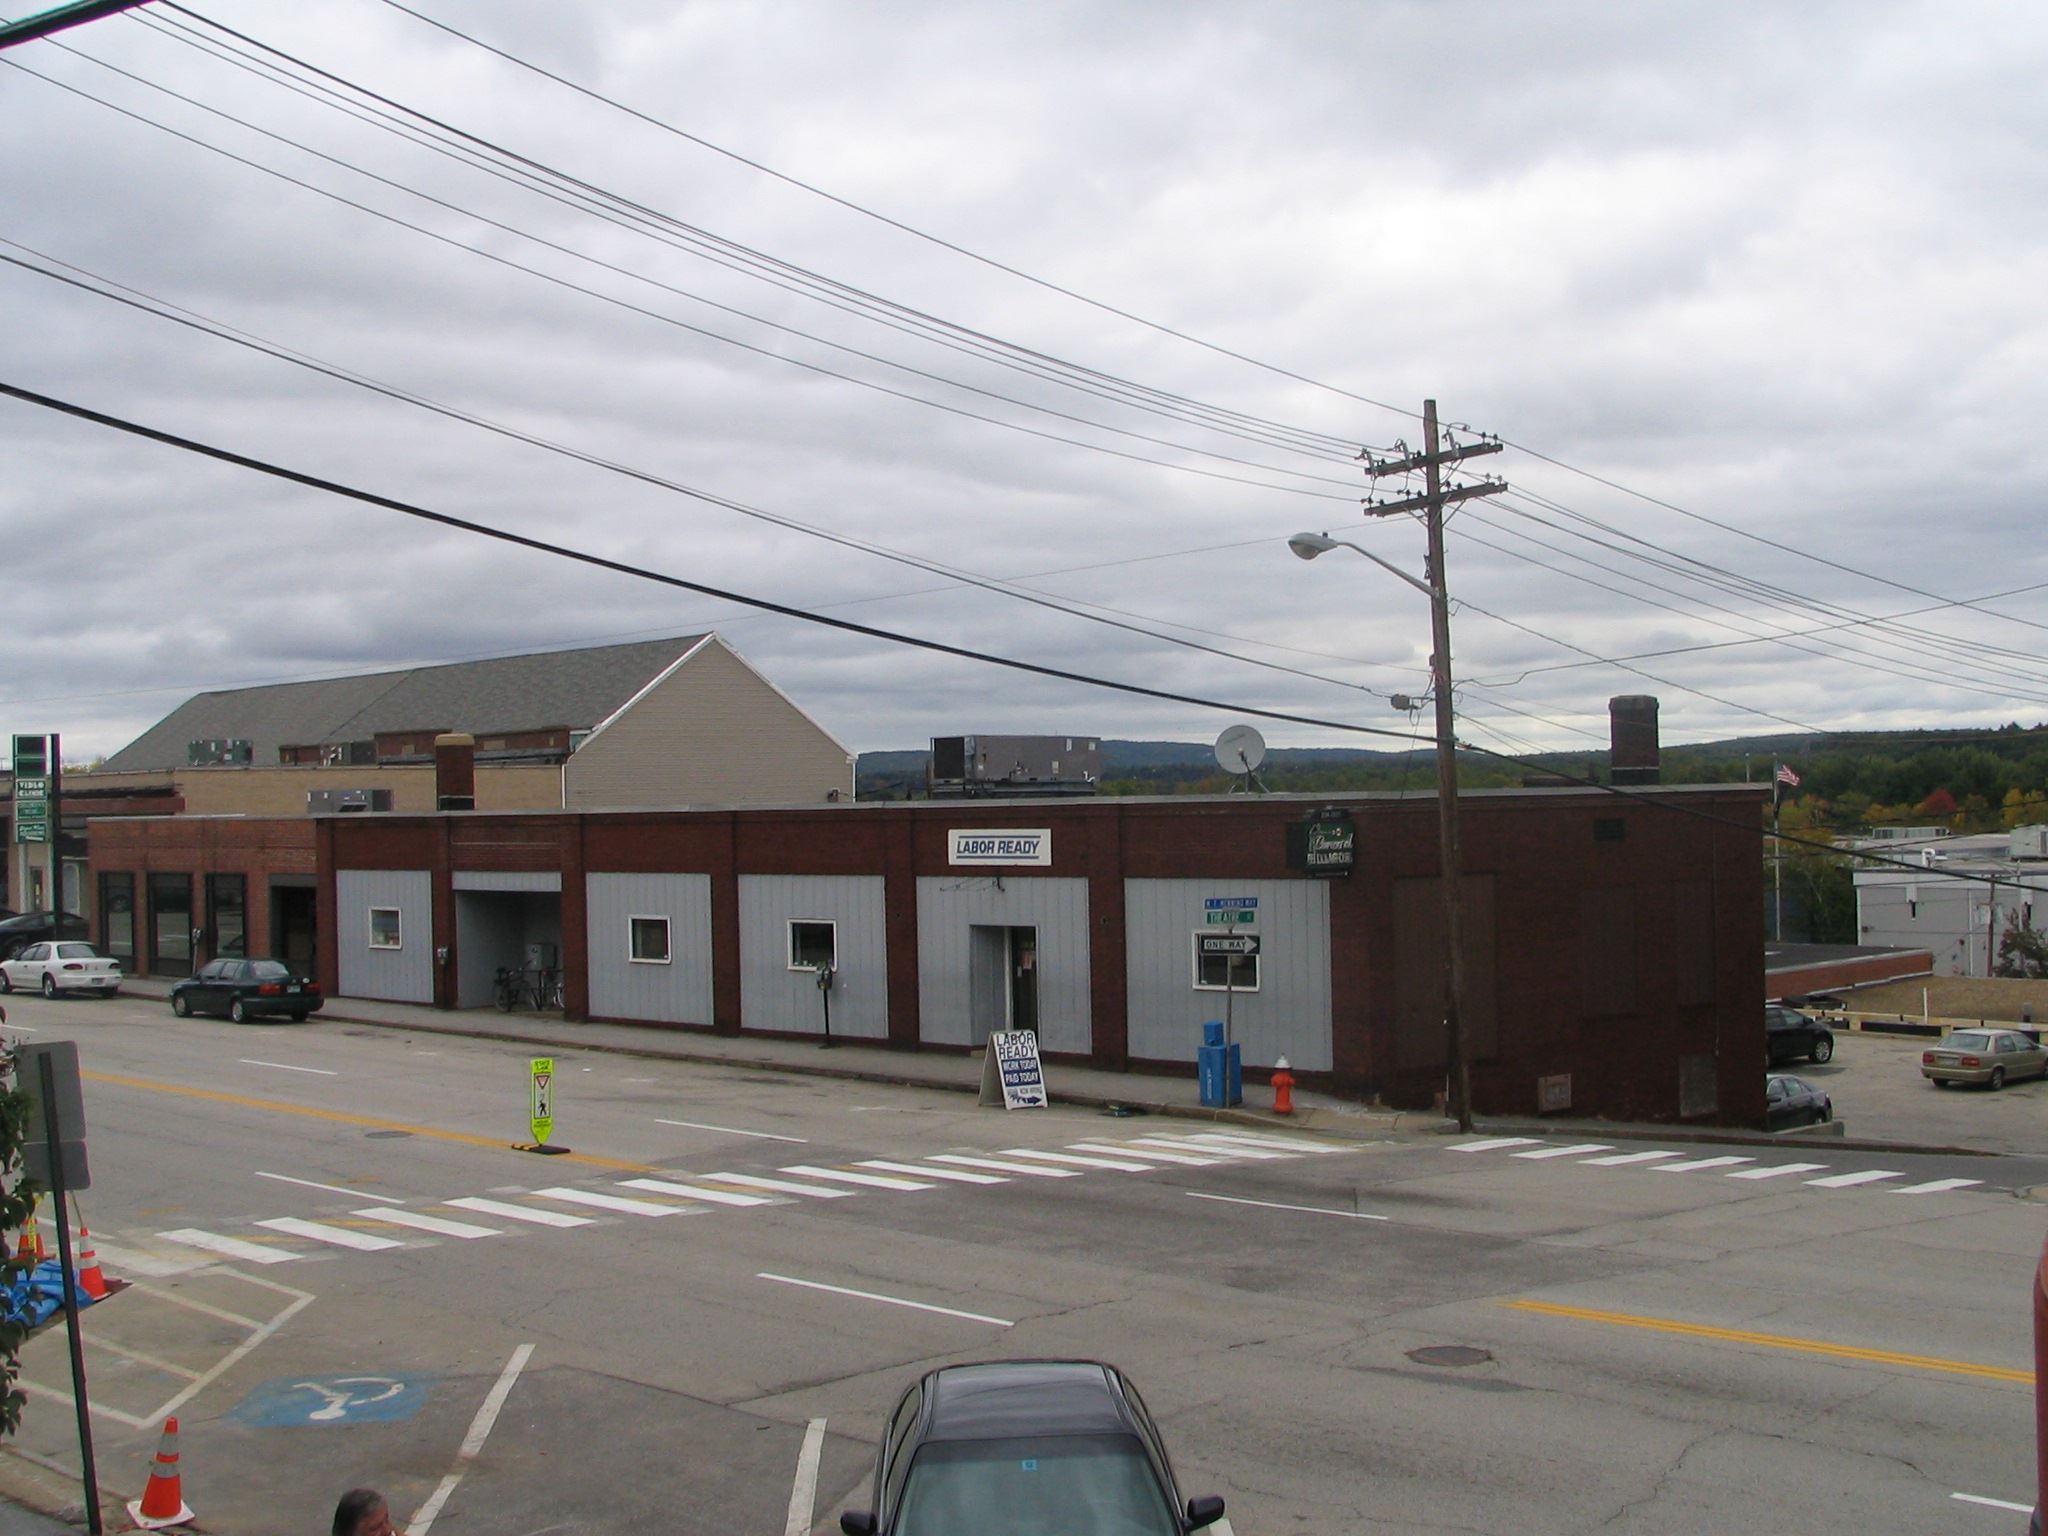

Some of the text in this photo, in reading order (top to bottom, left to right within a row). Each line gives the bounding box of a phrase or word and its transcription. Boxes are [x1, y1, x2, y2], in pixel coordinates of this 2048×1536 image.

[957, 840, 1040, 854] LABOR READY
[1206, 940, 1247, 949] ONE WAY
[996, 1032, 1034, 1047] LABOR
[999, 1045, 1036, 1059] READY
[1019, 1059, 1037, 1070] TODAY
[1005, 1071, 1039, 1083] PAID TODAY
